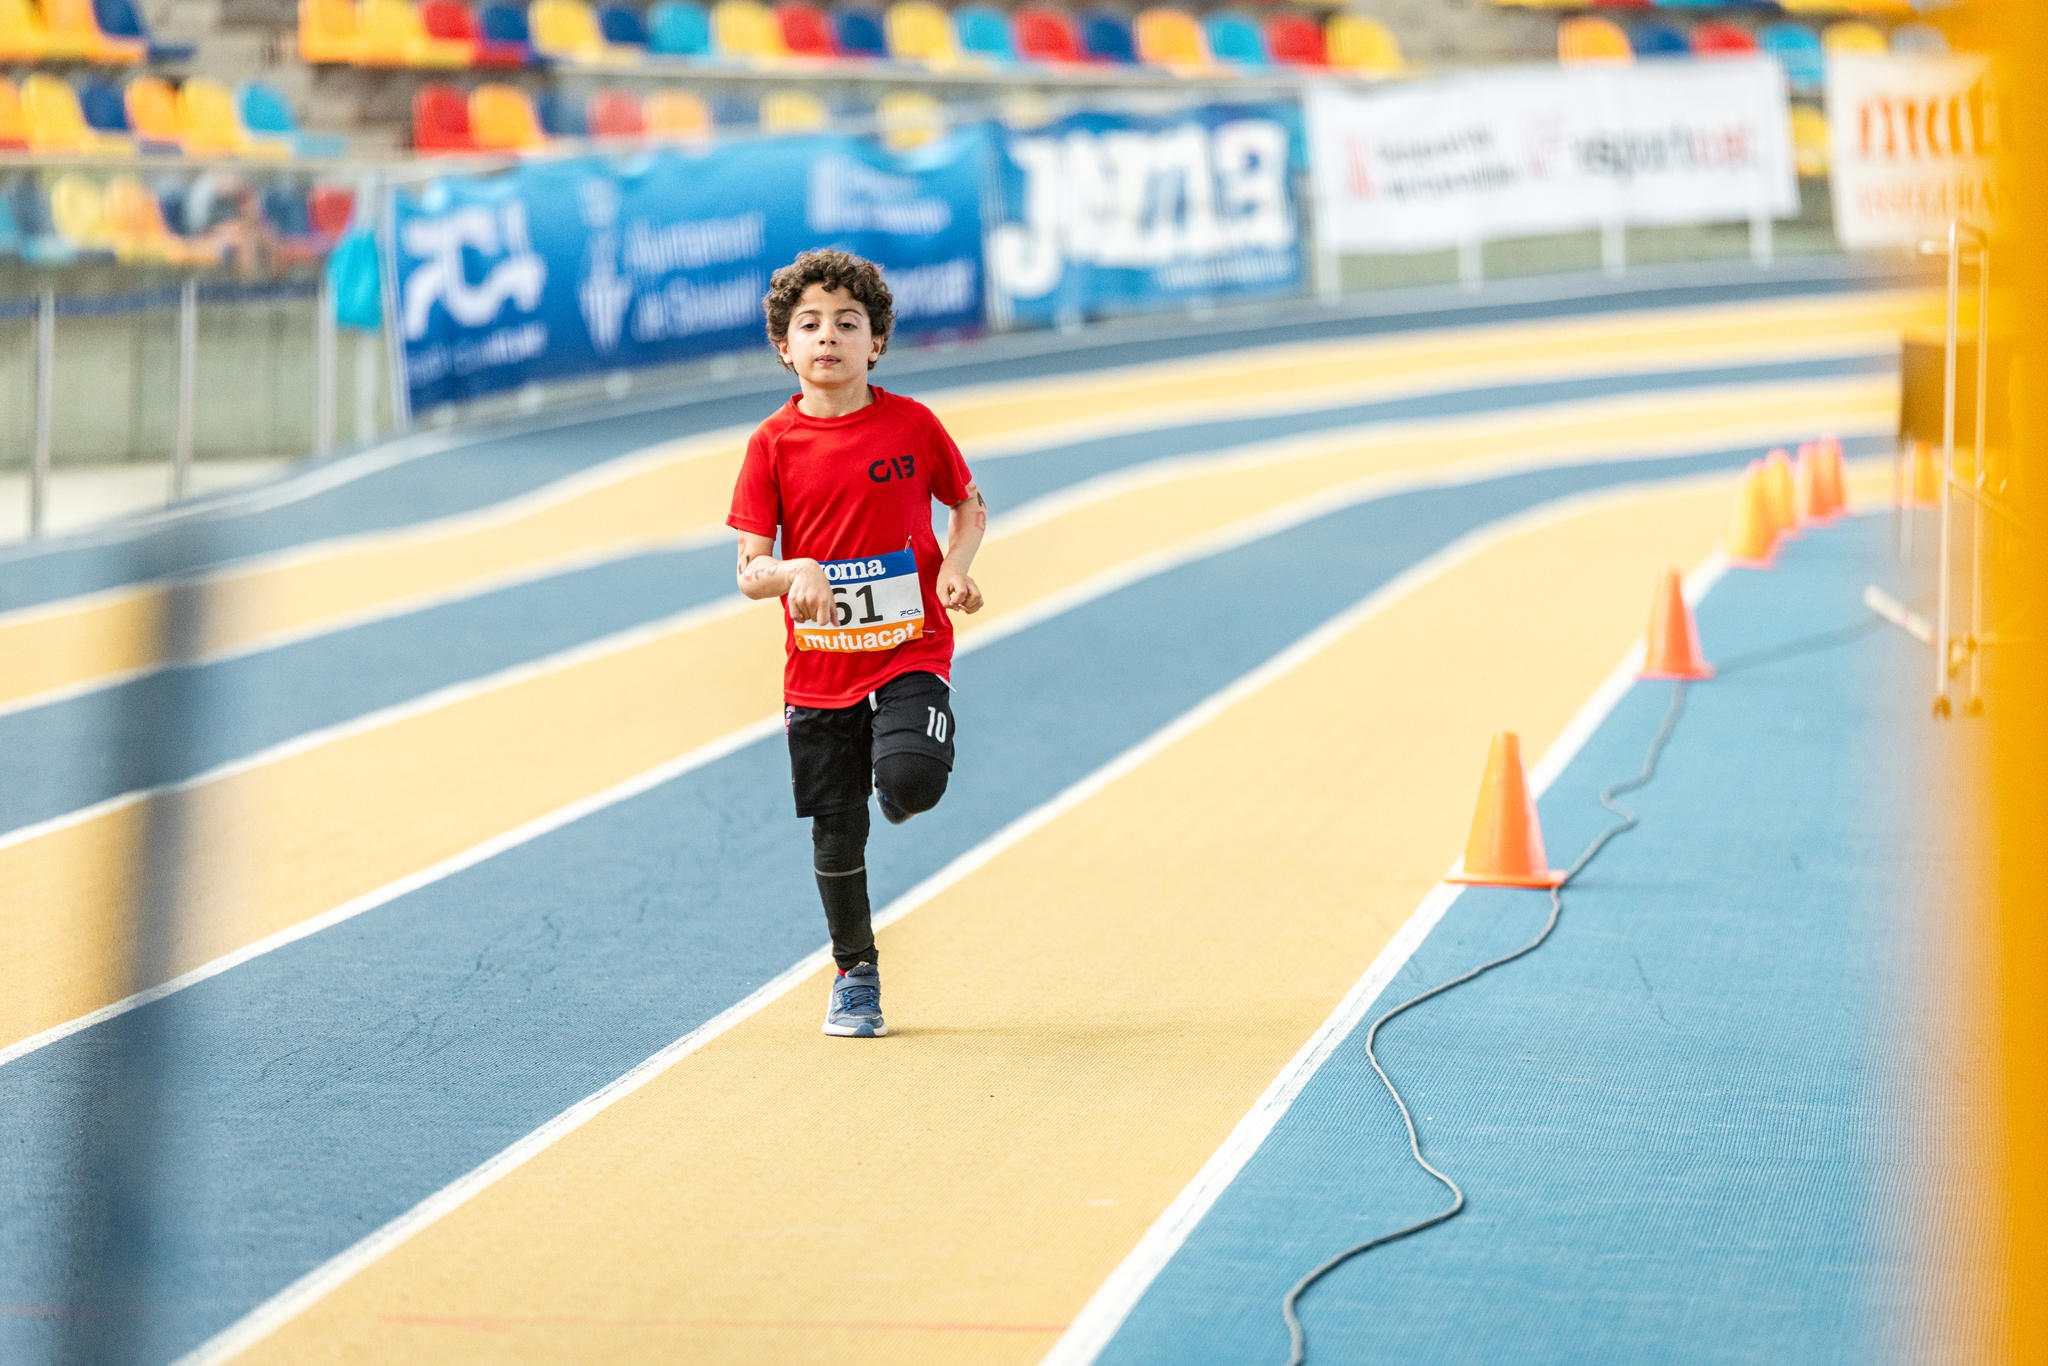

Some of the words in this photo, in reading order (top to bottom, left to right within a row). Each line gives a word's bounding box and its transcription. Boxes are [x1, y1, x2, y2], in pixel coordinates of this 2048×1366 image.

[821, 559, 886, 581] oma
[803, 622, 916, 650] mutuacat
[926, 706, 948, 744] 10
